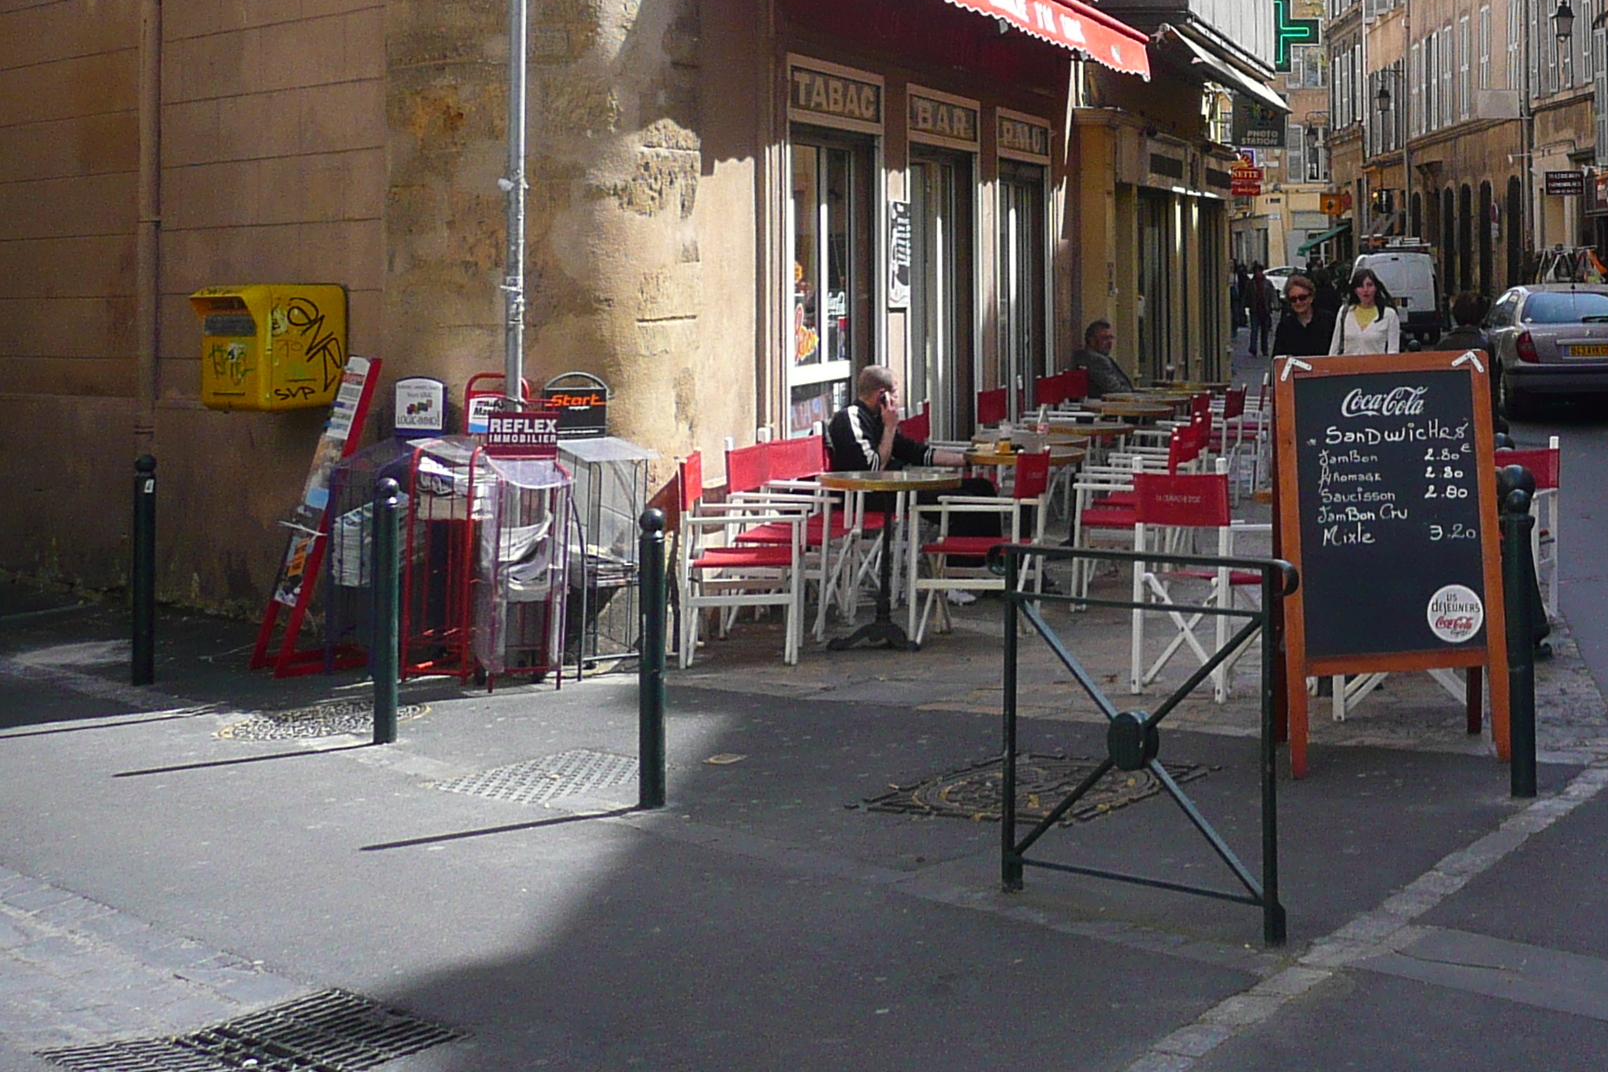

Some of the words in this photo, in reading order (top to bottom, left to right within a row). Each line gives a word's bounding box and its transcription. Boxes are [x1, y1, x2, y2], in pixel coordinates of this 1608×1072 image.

[795, 71, 875, 118] TABAC
[918, 101, 968, 137] BAR
[1240, 137, 1279, 146] STATION
[1246, 130, 1279, 138] PHOTO
[275, 386, 316, 401] SVP
[545, 393, 608, 407] Start
[489, 418, 558, 433] REFLEX
[488, 434, 557, 444] IMMOBILIER
[1321, 487, 1396, 504] Saucisson
[1424, 484, 1468, 499] 2.80
[1379, 503, 1408, 520] Cru
[1322, 521, 1376, 547] Mixte
[1429, 523, 1477, 541] 3.20
